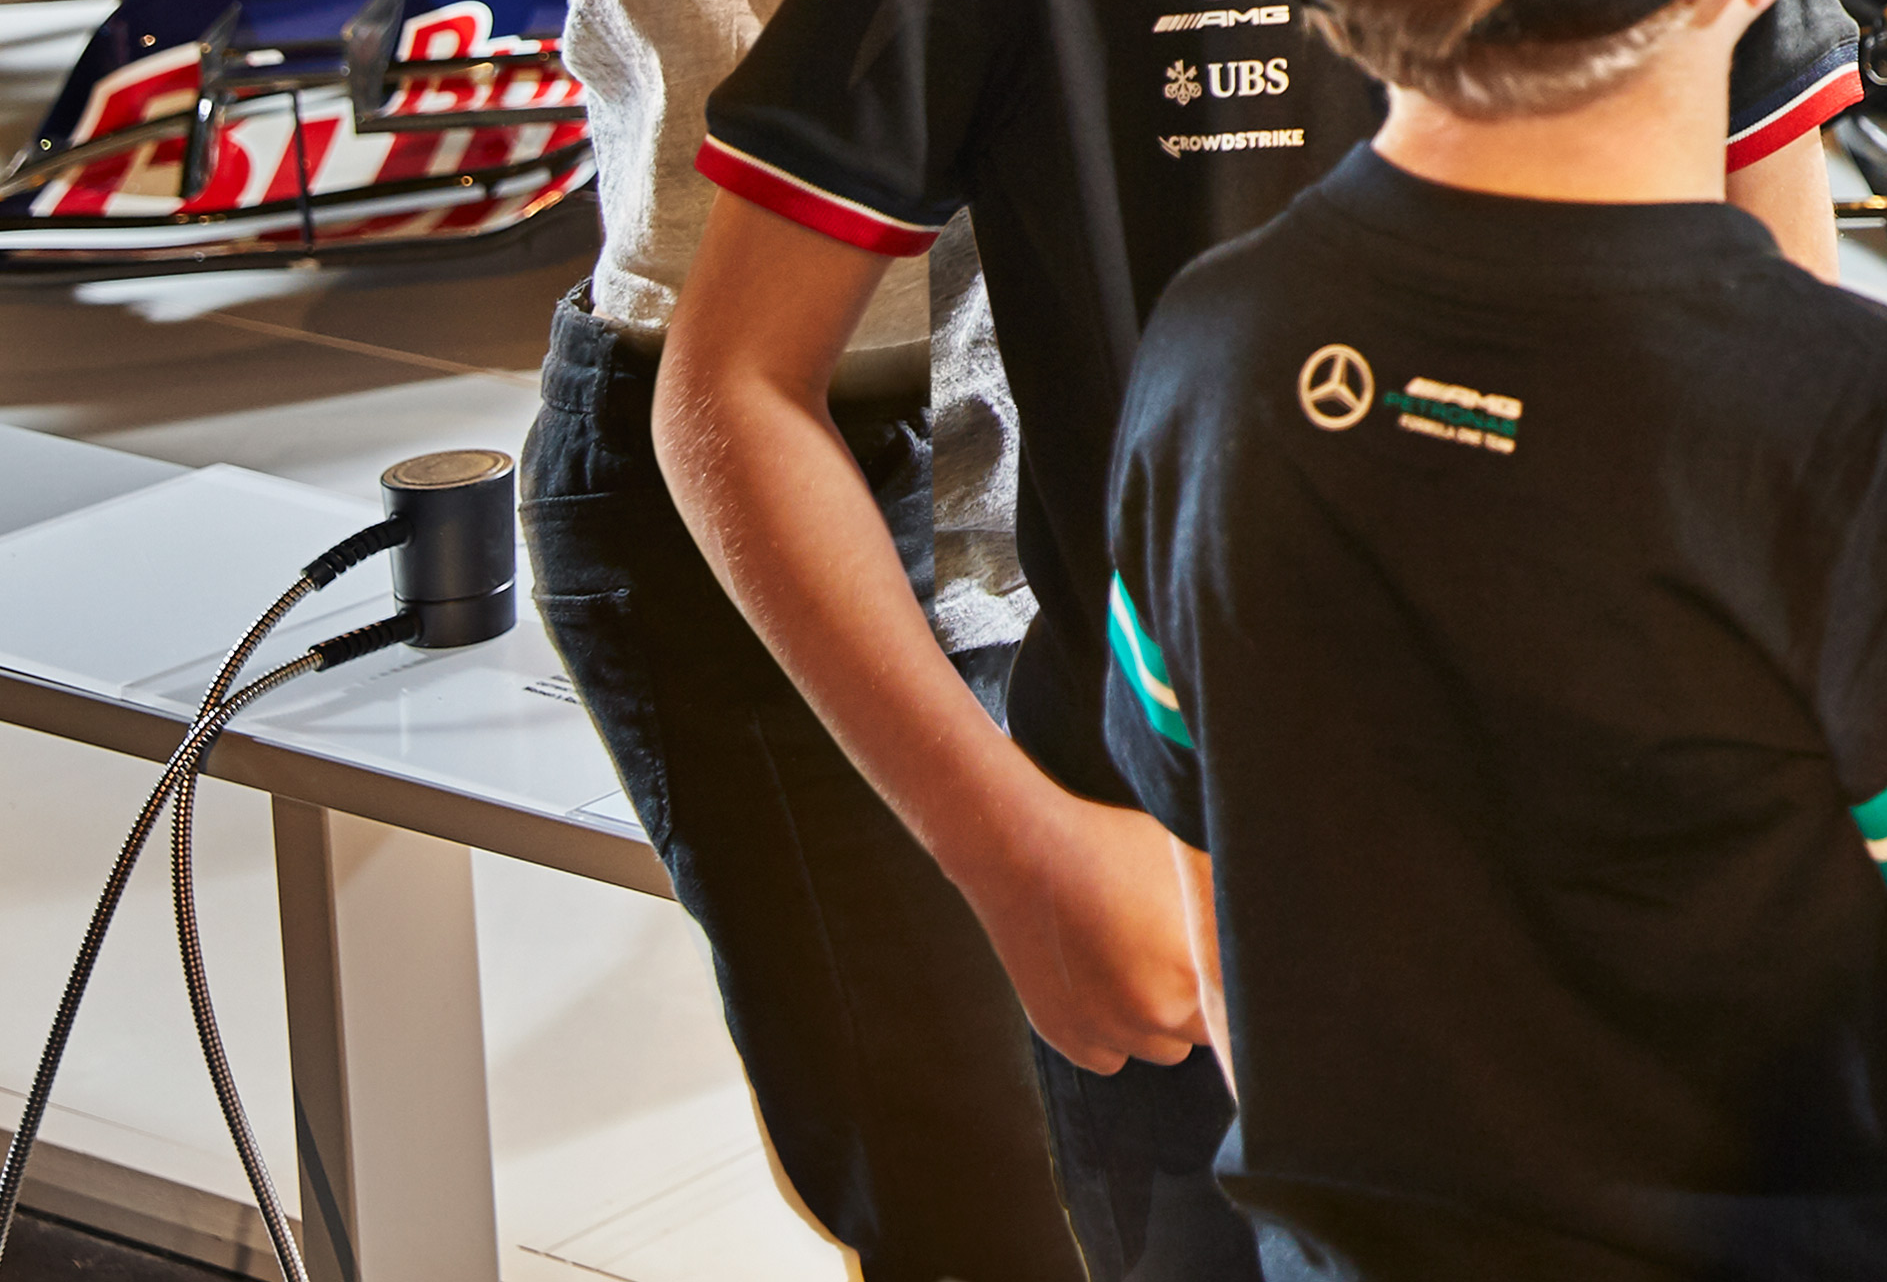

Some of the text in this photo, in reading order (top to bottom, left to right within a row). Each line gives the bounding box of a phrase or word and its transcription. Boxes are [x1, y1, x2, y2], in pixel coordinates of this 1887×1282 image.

[1197, 4, 1290, 30] AMG
[1208, 57, 1290, 99] UBS
[1168, 128, 1305, 152] CROWDSTRIKE
